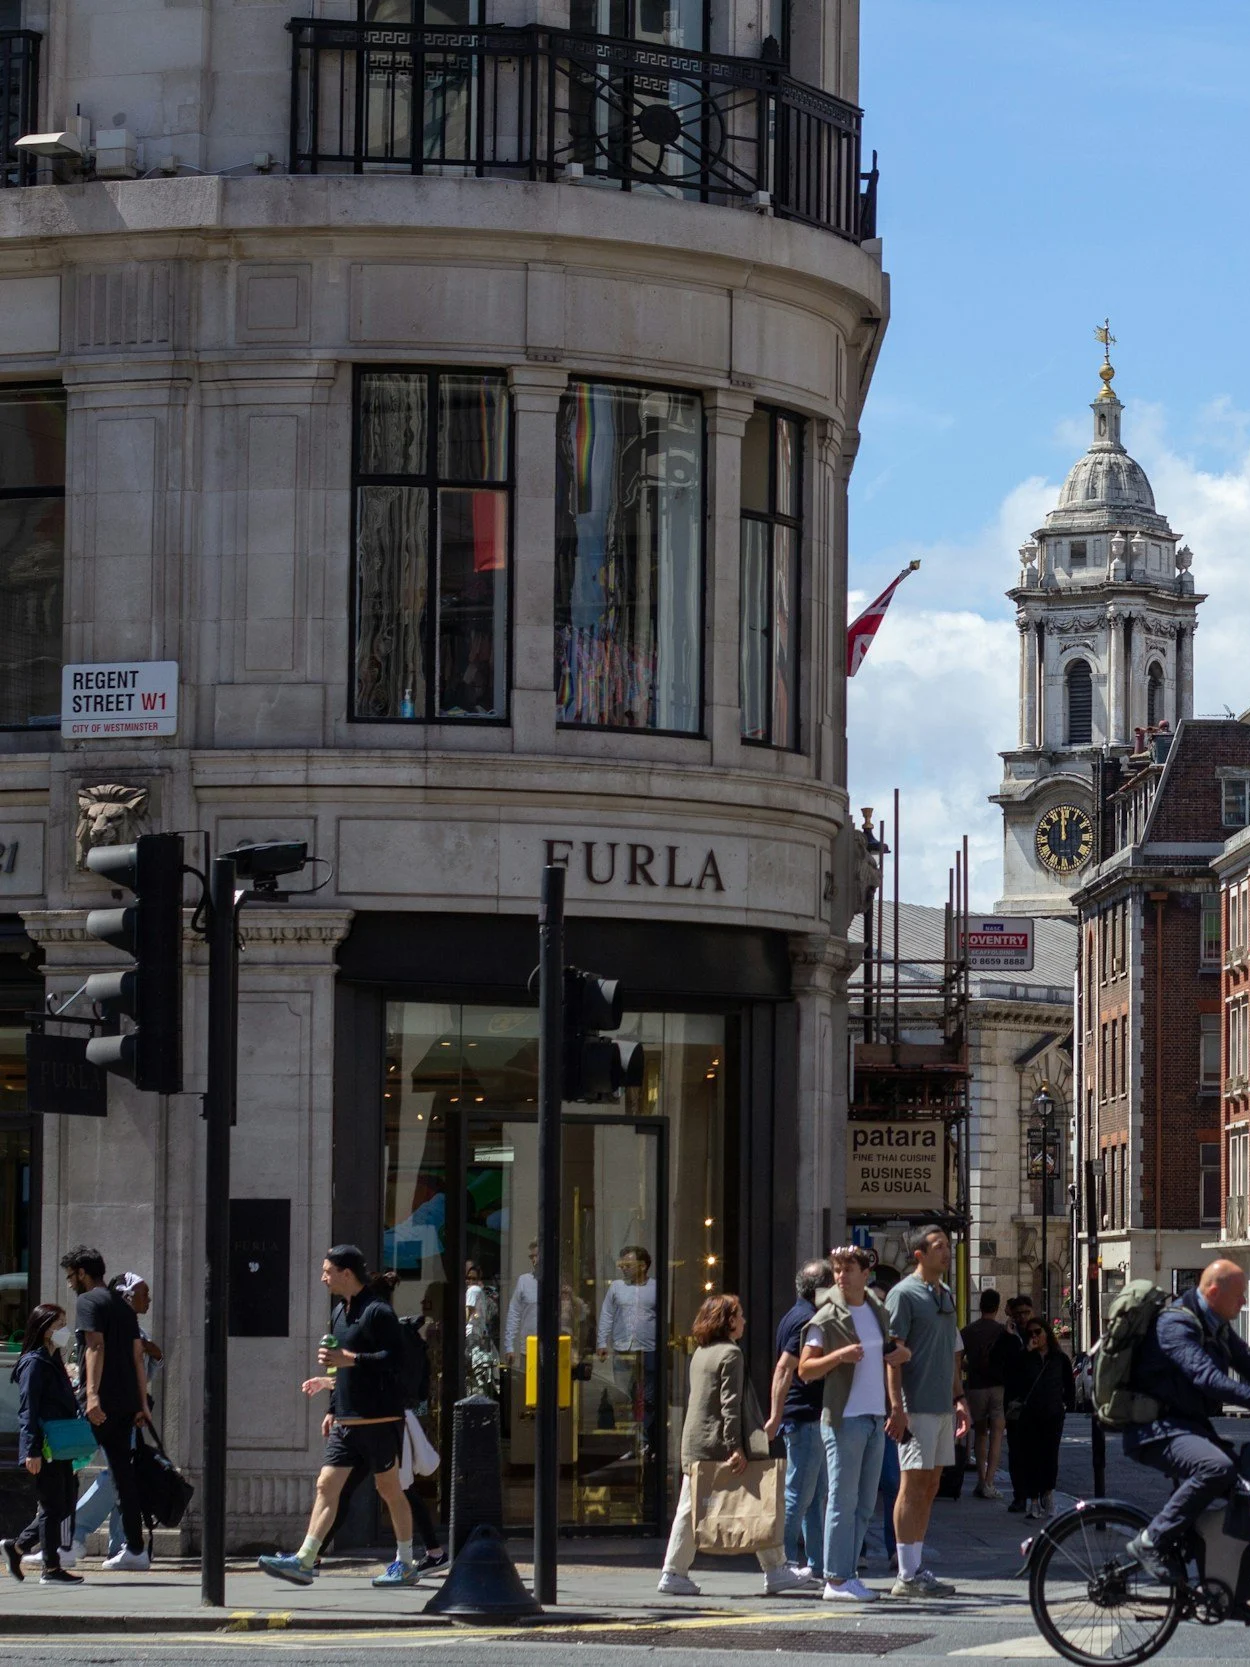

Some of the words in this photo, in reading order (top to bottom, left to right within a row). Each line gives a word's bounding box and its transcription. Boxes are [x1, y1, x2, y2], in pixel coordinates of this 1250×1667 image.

[73, 670, 139, 690] REGENT
[72, 693, 135, 713] STREET
[141, 692, 166, 711] W1
[72, 724, 90, 733] CITY
[91, 723, 102, 732] OF
[103, 722, 159, 732] WESTMINSTER
[542, 839, 726, 892] FURLA
[853, 1126, 937, 1153] patara
[853, 1153, 874, 1162] FINE
[877, 1153, 898, 1162] THAI
[900, 1153, 937, 1163] CUISINE
[861, 1167, 932, 1179] BUSINESS
[860, 1181, 880, 1193] AS
[884, 1181, 932, 1193] USUAL
